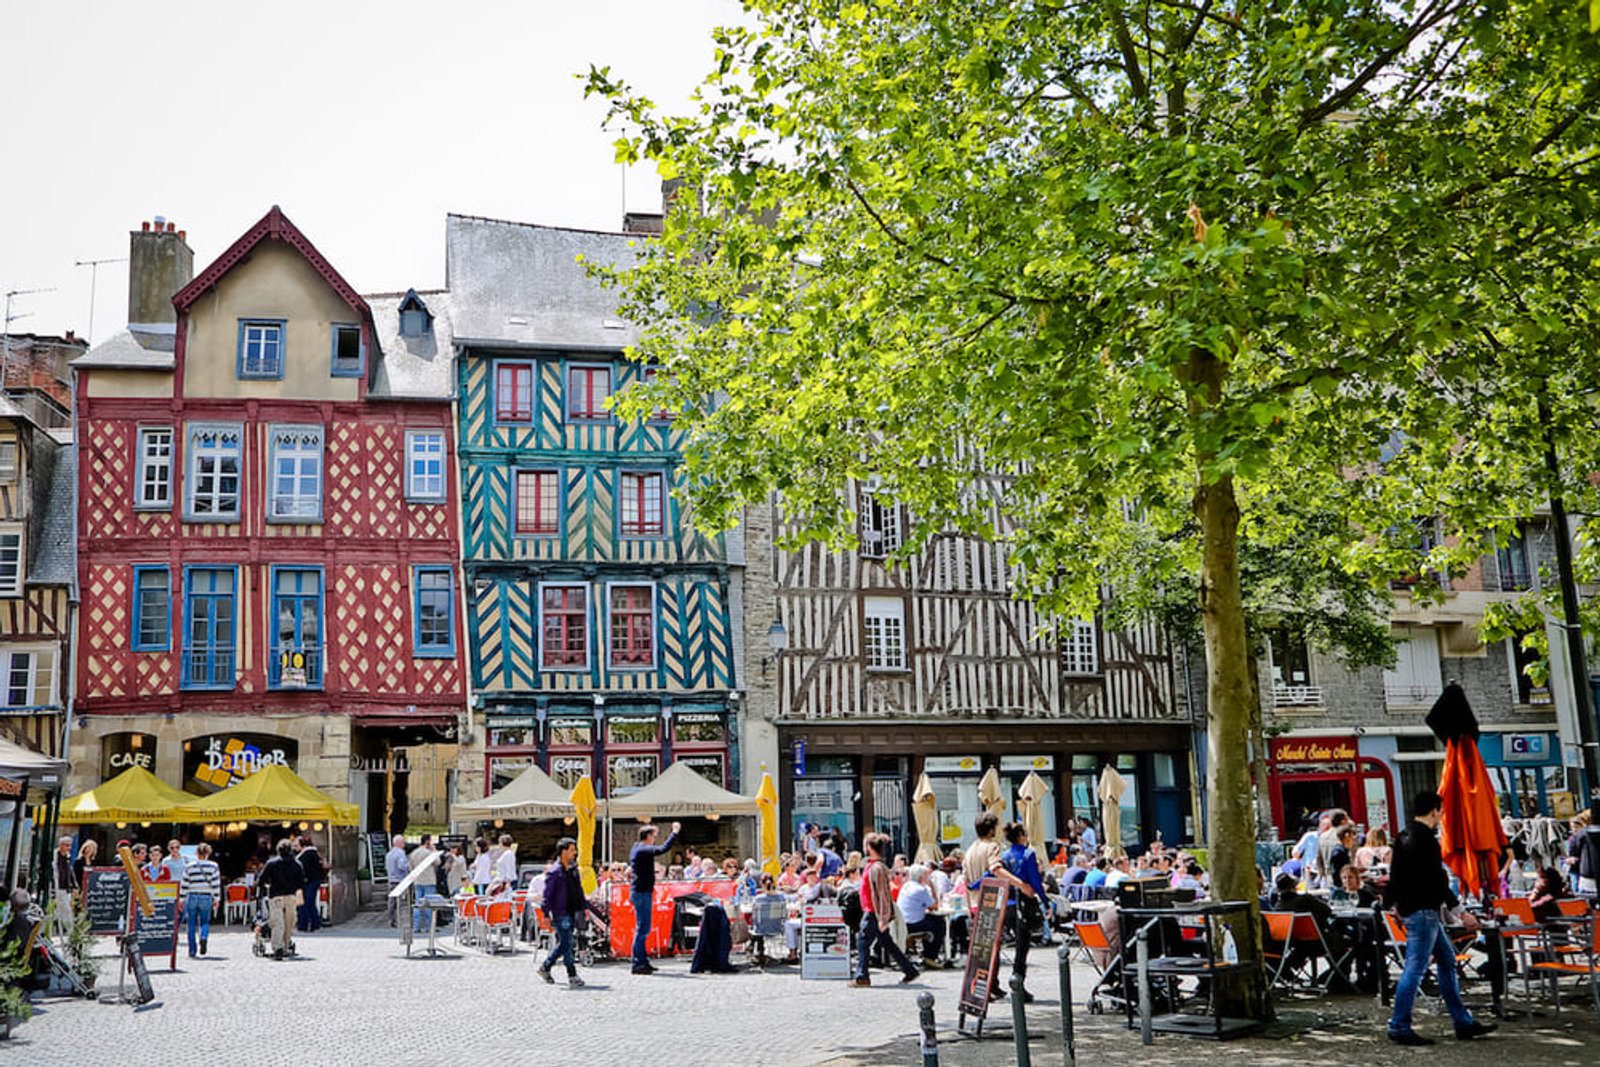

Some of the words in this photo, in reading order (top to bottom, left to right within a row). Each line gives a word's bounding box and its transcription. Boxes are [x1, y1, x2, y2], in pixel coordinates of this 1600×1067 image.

[678, 713, 720, 722] PIZZERIA
[1514, 739, 1541, 752] CIC
[656, 803, 715, 812] PIZZERIA
